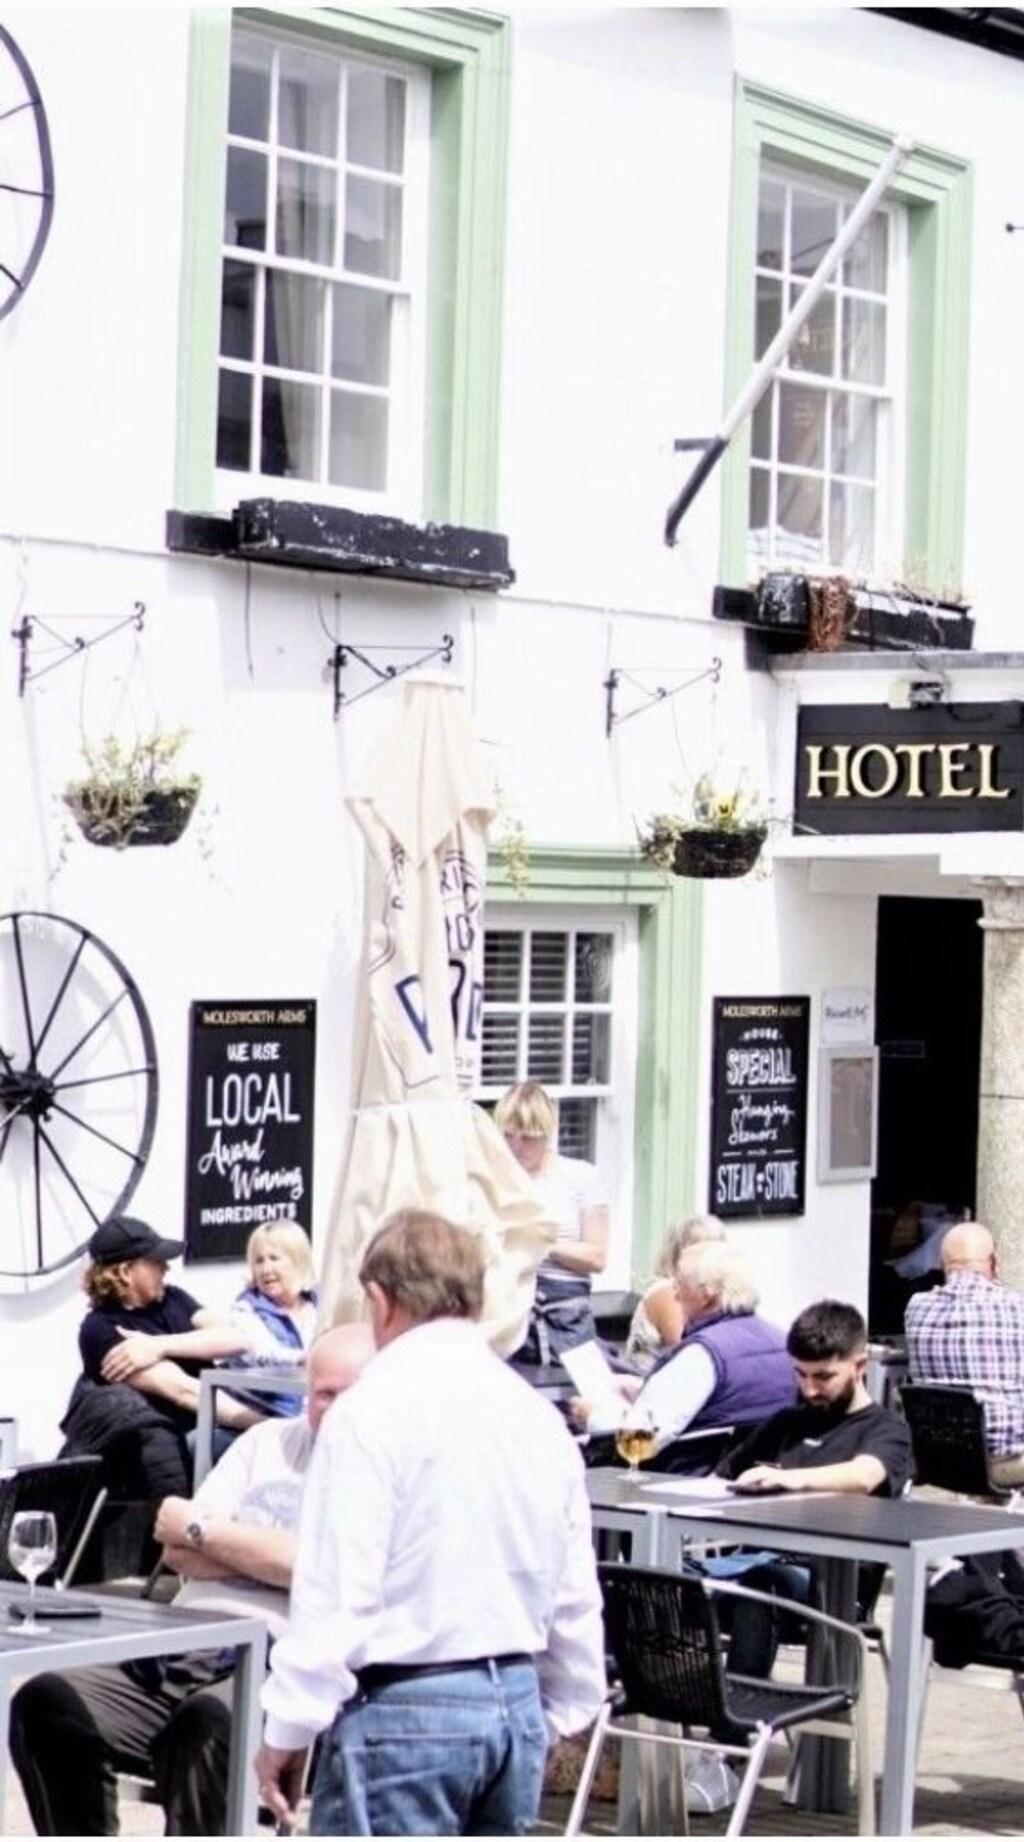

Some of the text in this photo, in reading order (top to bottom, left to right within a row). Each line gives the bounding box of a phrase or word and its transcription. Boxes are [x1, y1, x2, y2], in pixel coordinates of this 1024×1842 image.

[805, 743, 1010, 799] HOTEL
[203, 1009, 275, 1025] MOLESWORTH
[227, 1041, 281, 1062] WE USE
[726, 1047, 797, 1087] SPECIAL
[205, 1072, 301, 1127] LOCAL
[198, 1128, 265, 1176] Award
[230, 1163, 304, 1201] Winning
[201, 1202, 298, 1226] INGREDIENTS
